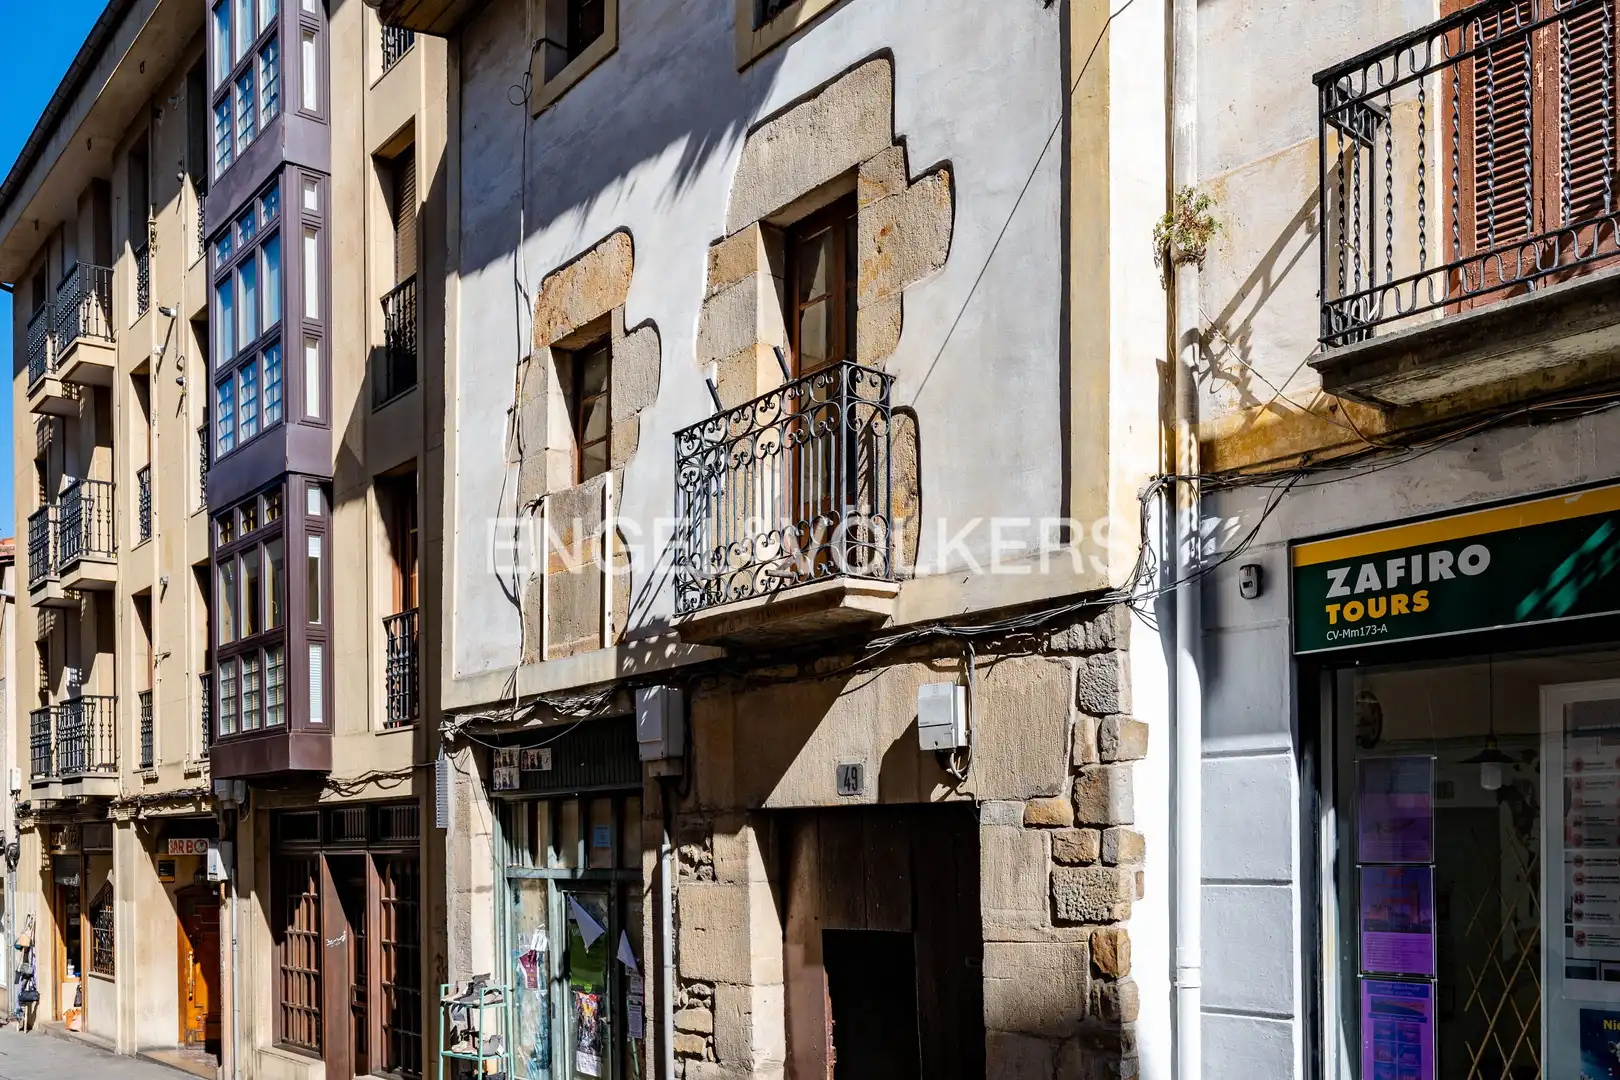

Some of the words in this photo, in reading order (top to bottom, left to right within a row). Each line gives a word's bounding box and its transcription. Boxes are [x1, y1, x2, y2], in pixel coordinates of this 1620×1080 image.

[1326, 544, 1491, 599] ZAFIRO
[1326, 589, 1430, 625] TOURS
[1326, 623, 1388, 641] CV-Mm173-A
[843, 766, 858, 791] 49
[169, 839, 184, 854] BAR
